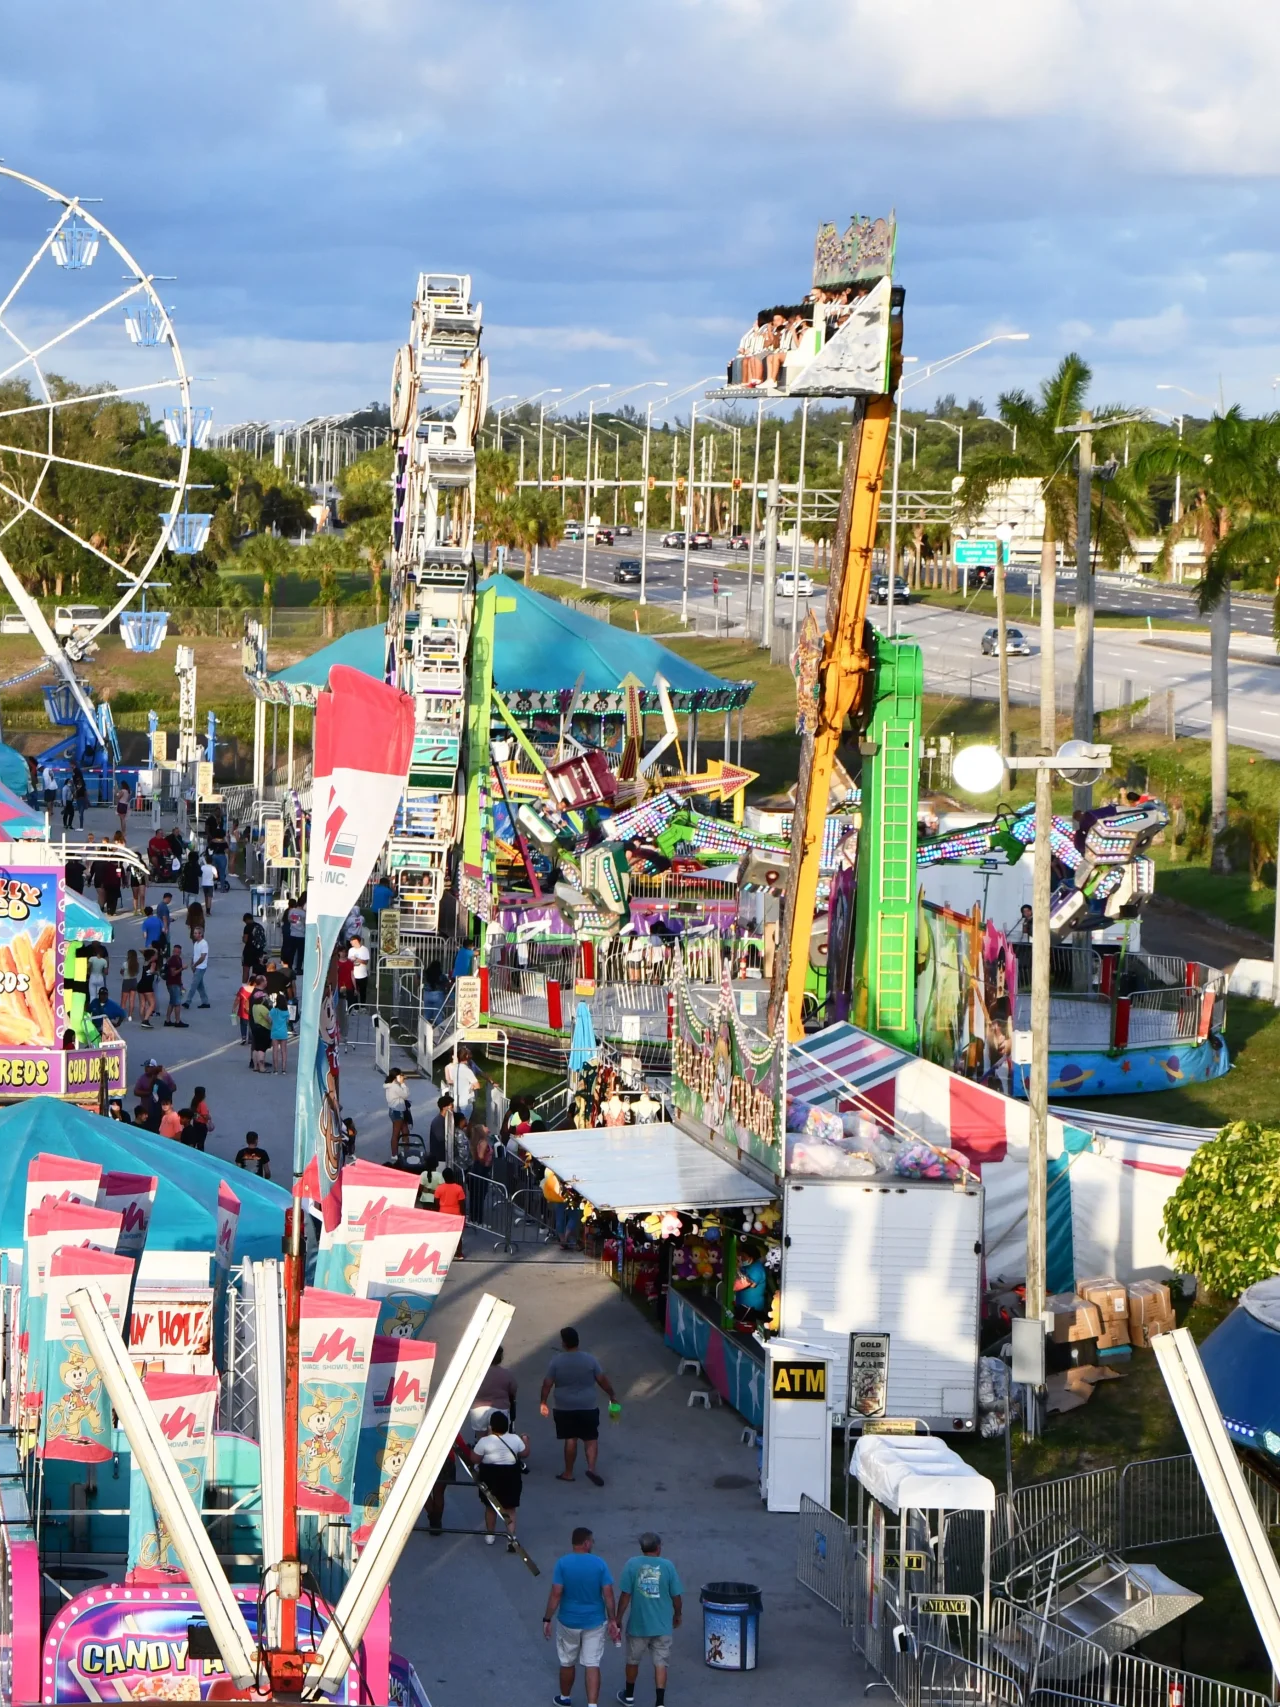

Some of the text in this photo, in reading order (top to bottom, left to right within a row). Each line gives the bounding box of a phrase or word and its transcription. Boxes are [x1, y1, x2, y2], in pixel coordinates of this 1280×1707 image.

[68, 1057, 86, 1084] COLD
[774, 1368, 825, 1392] ATM
[884, 1555, 920, 1569] EXIT
[923, 1599, 967, 1612] ENTRANCE
[82, 1639, 189, 1676] CANDY
